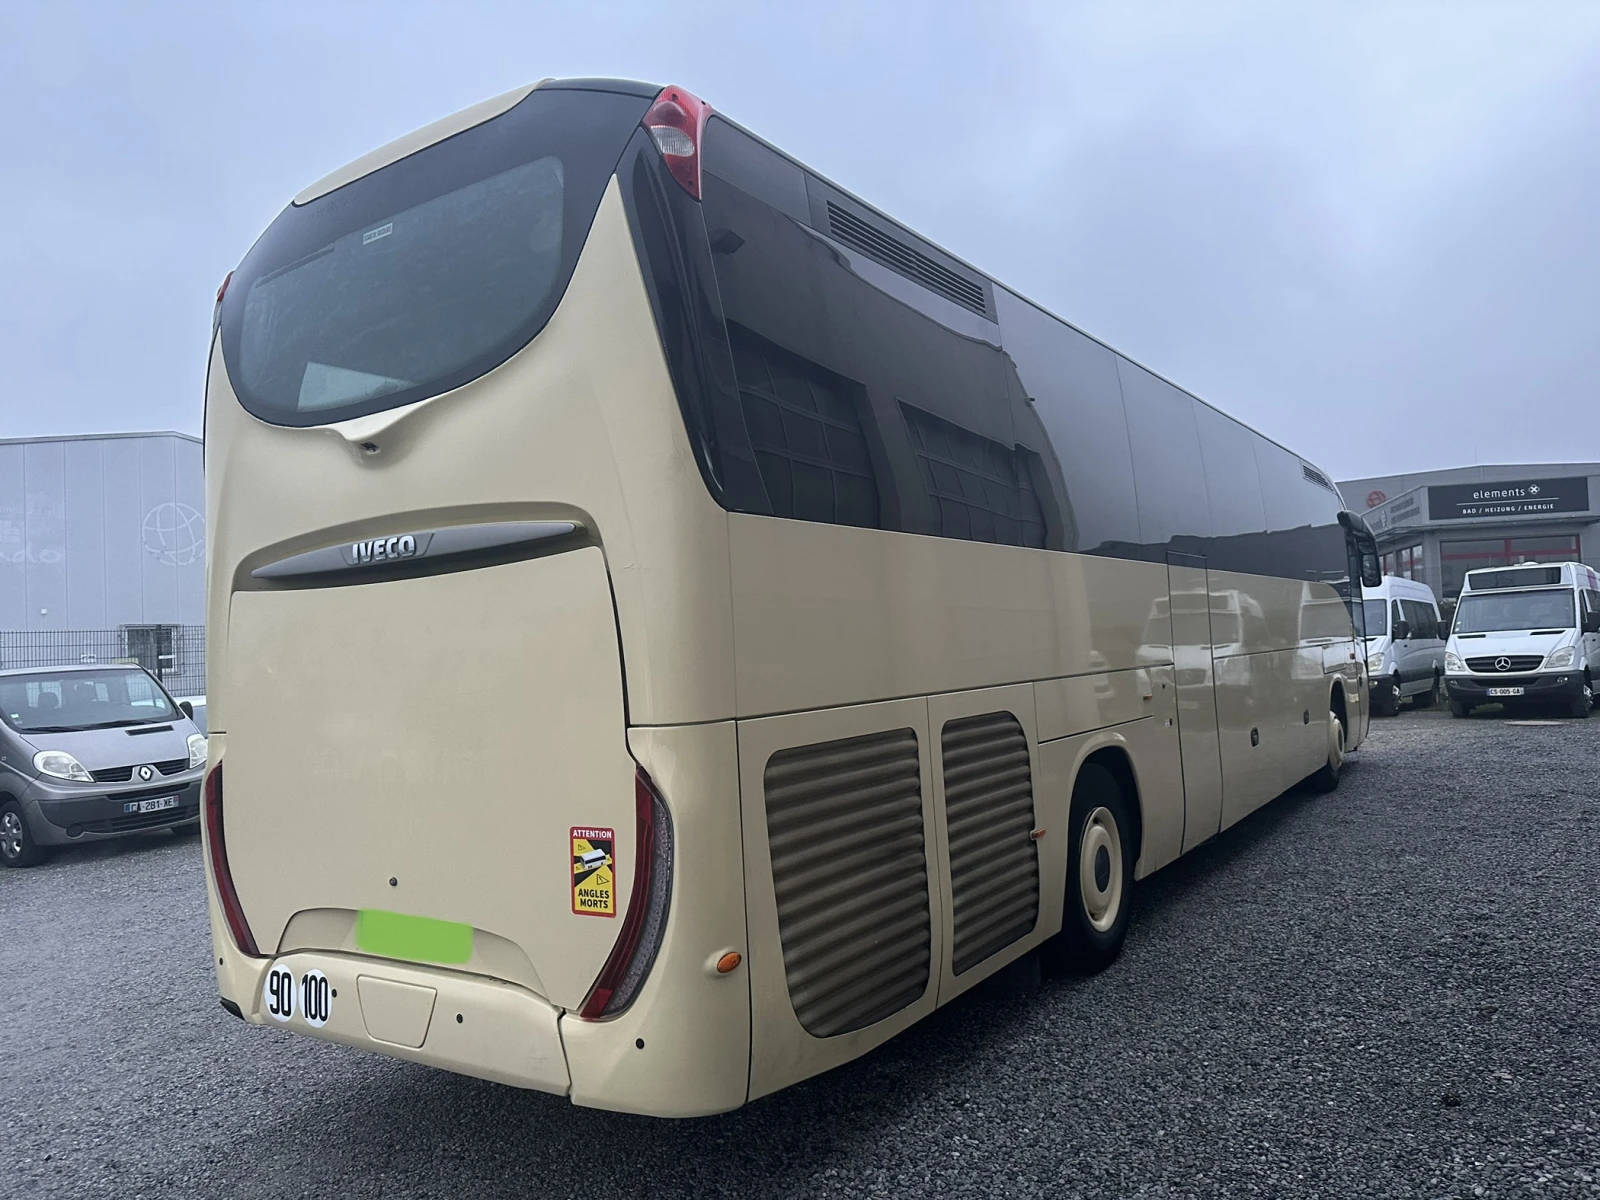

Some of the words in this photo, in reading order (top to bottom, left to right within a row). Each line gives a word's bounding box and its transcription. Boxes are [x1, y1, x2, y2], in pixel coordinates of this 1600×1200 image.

[1473, 487, 1526, 499] elements
[1524, 503, 1555, 511] ENERGIE
[352, 535, 415, 564] IVECO
[572, 829, 612, 839] ATTENTION
[578, 888, 610, 899] ANGLES
[580, 898, 609, 909] MORTS
[269, 970, 292, 1017] 90
[302, 974, 328, 1022] 100
